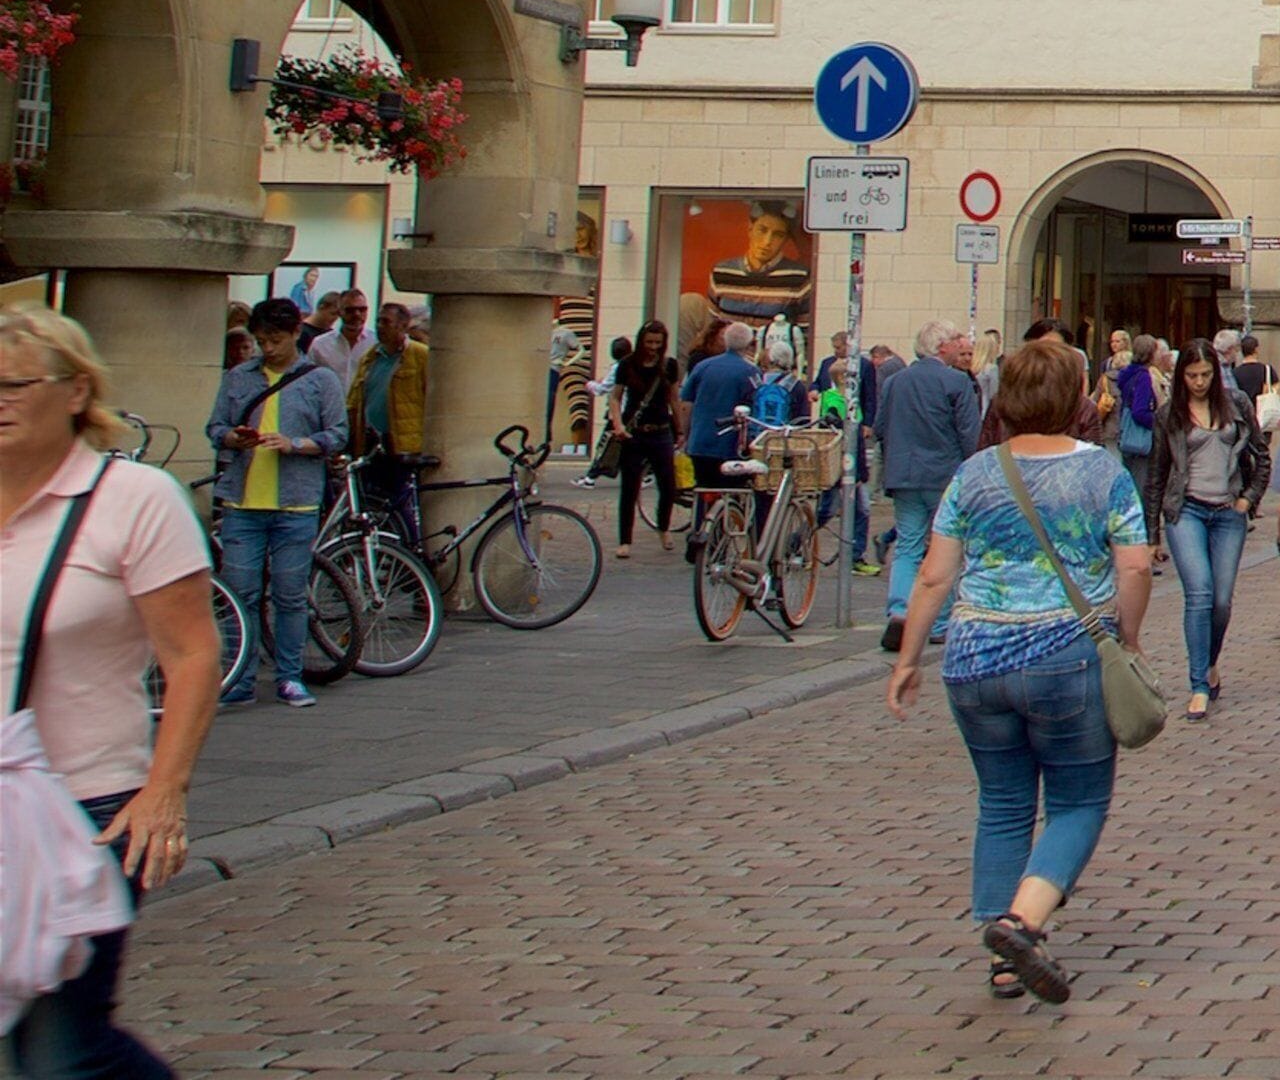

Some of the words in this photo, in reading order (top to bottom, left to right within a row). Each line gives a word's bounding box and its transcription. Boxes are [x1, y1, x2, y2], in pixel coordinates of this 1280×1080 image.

[815, 165, 856, 179] Linien-
[825, 189, 848, 202] und
[842, 211, 869, 225] frei
[1131, 223, 1173, 233] TOMMY
